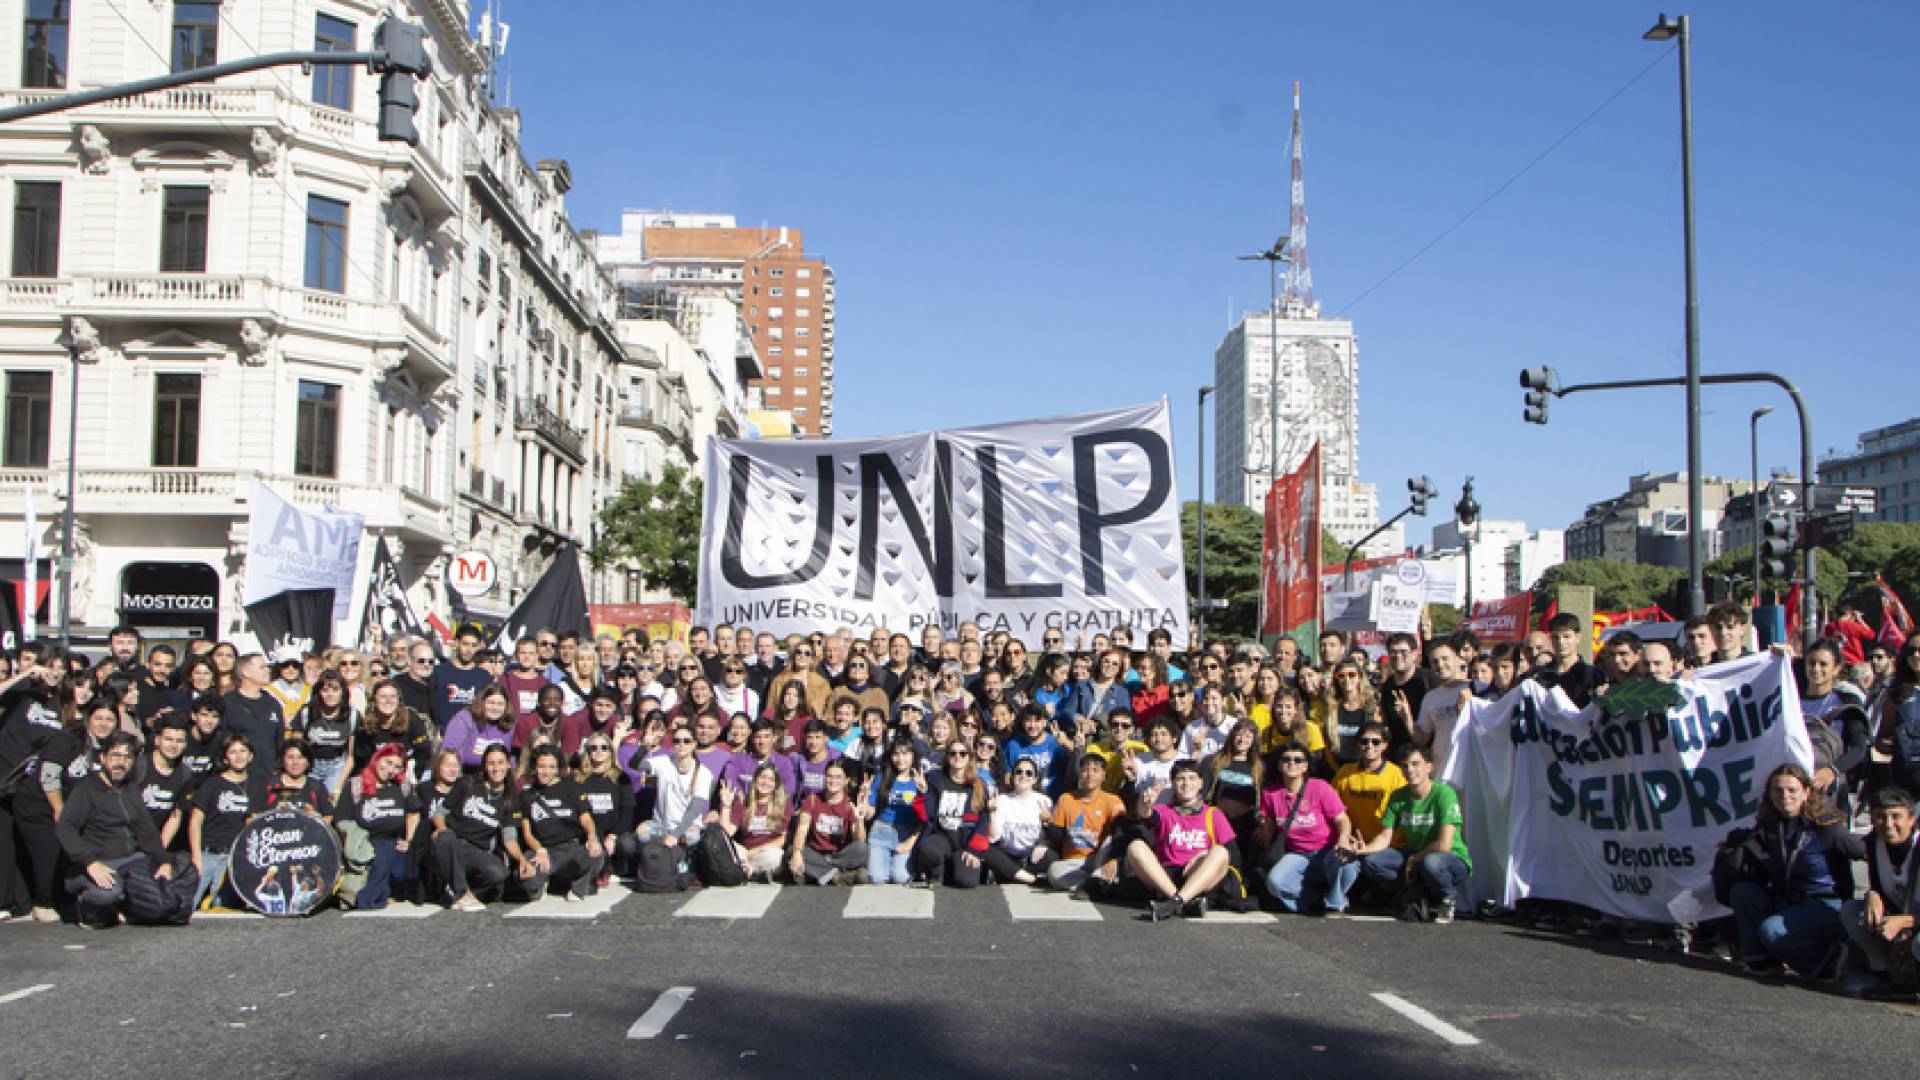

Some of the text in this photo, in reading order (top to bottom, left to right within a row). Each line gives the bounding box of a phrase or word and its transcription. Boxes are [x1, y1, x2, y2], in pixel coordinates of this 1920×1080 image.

[721, 428, 1171, 600] UNLP
[457, 557, 486, 581] M
[1018, 612, 1036, 632] Y
[1044, 607, 1179, 631] GRATUITA
[1603, 840, 1696, 873] Deportes
